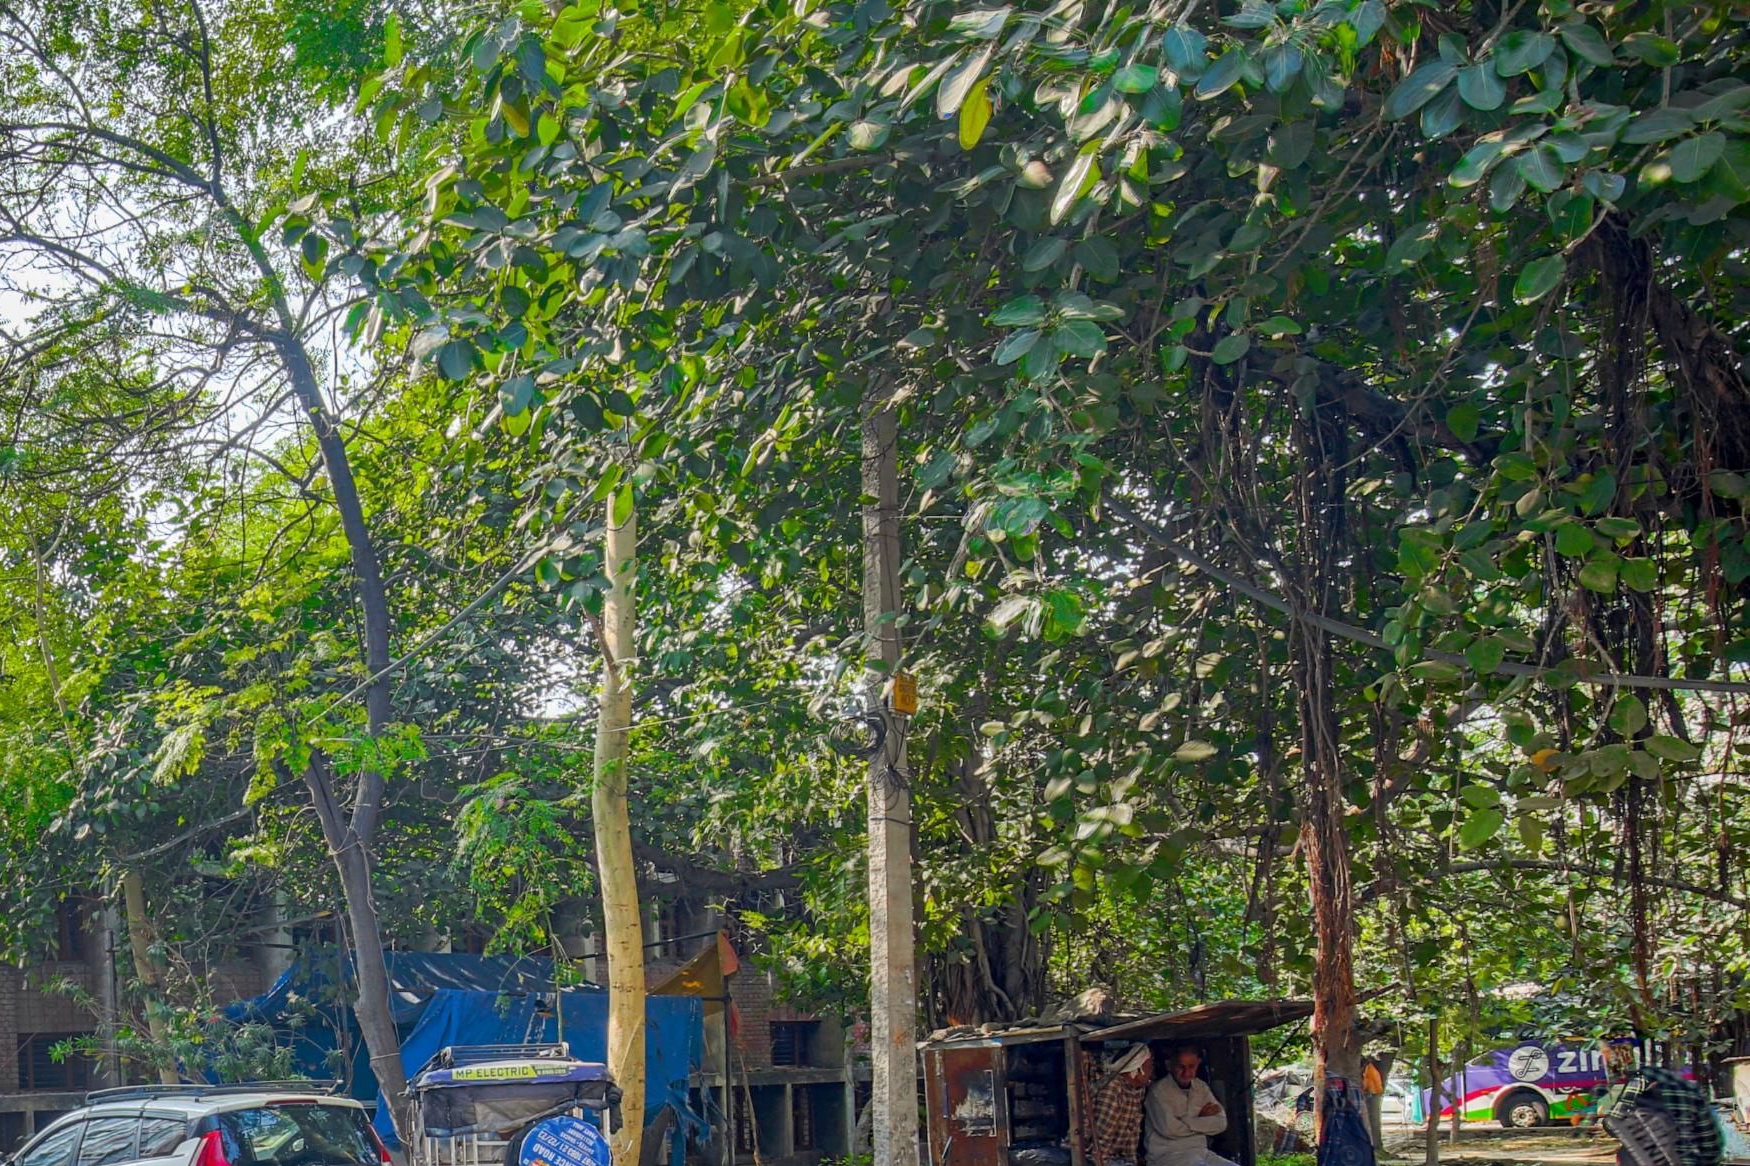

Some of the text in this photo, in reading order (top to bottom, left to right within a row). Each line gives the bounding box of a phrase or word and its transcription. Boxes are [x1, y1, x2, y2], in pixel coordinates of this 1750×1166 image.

[456, 1070, 472, 1079] MP
[476, 1067, 530, 1078] ELECTRIC
[532, 1142, 556, 1162] ROAD
